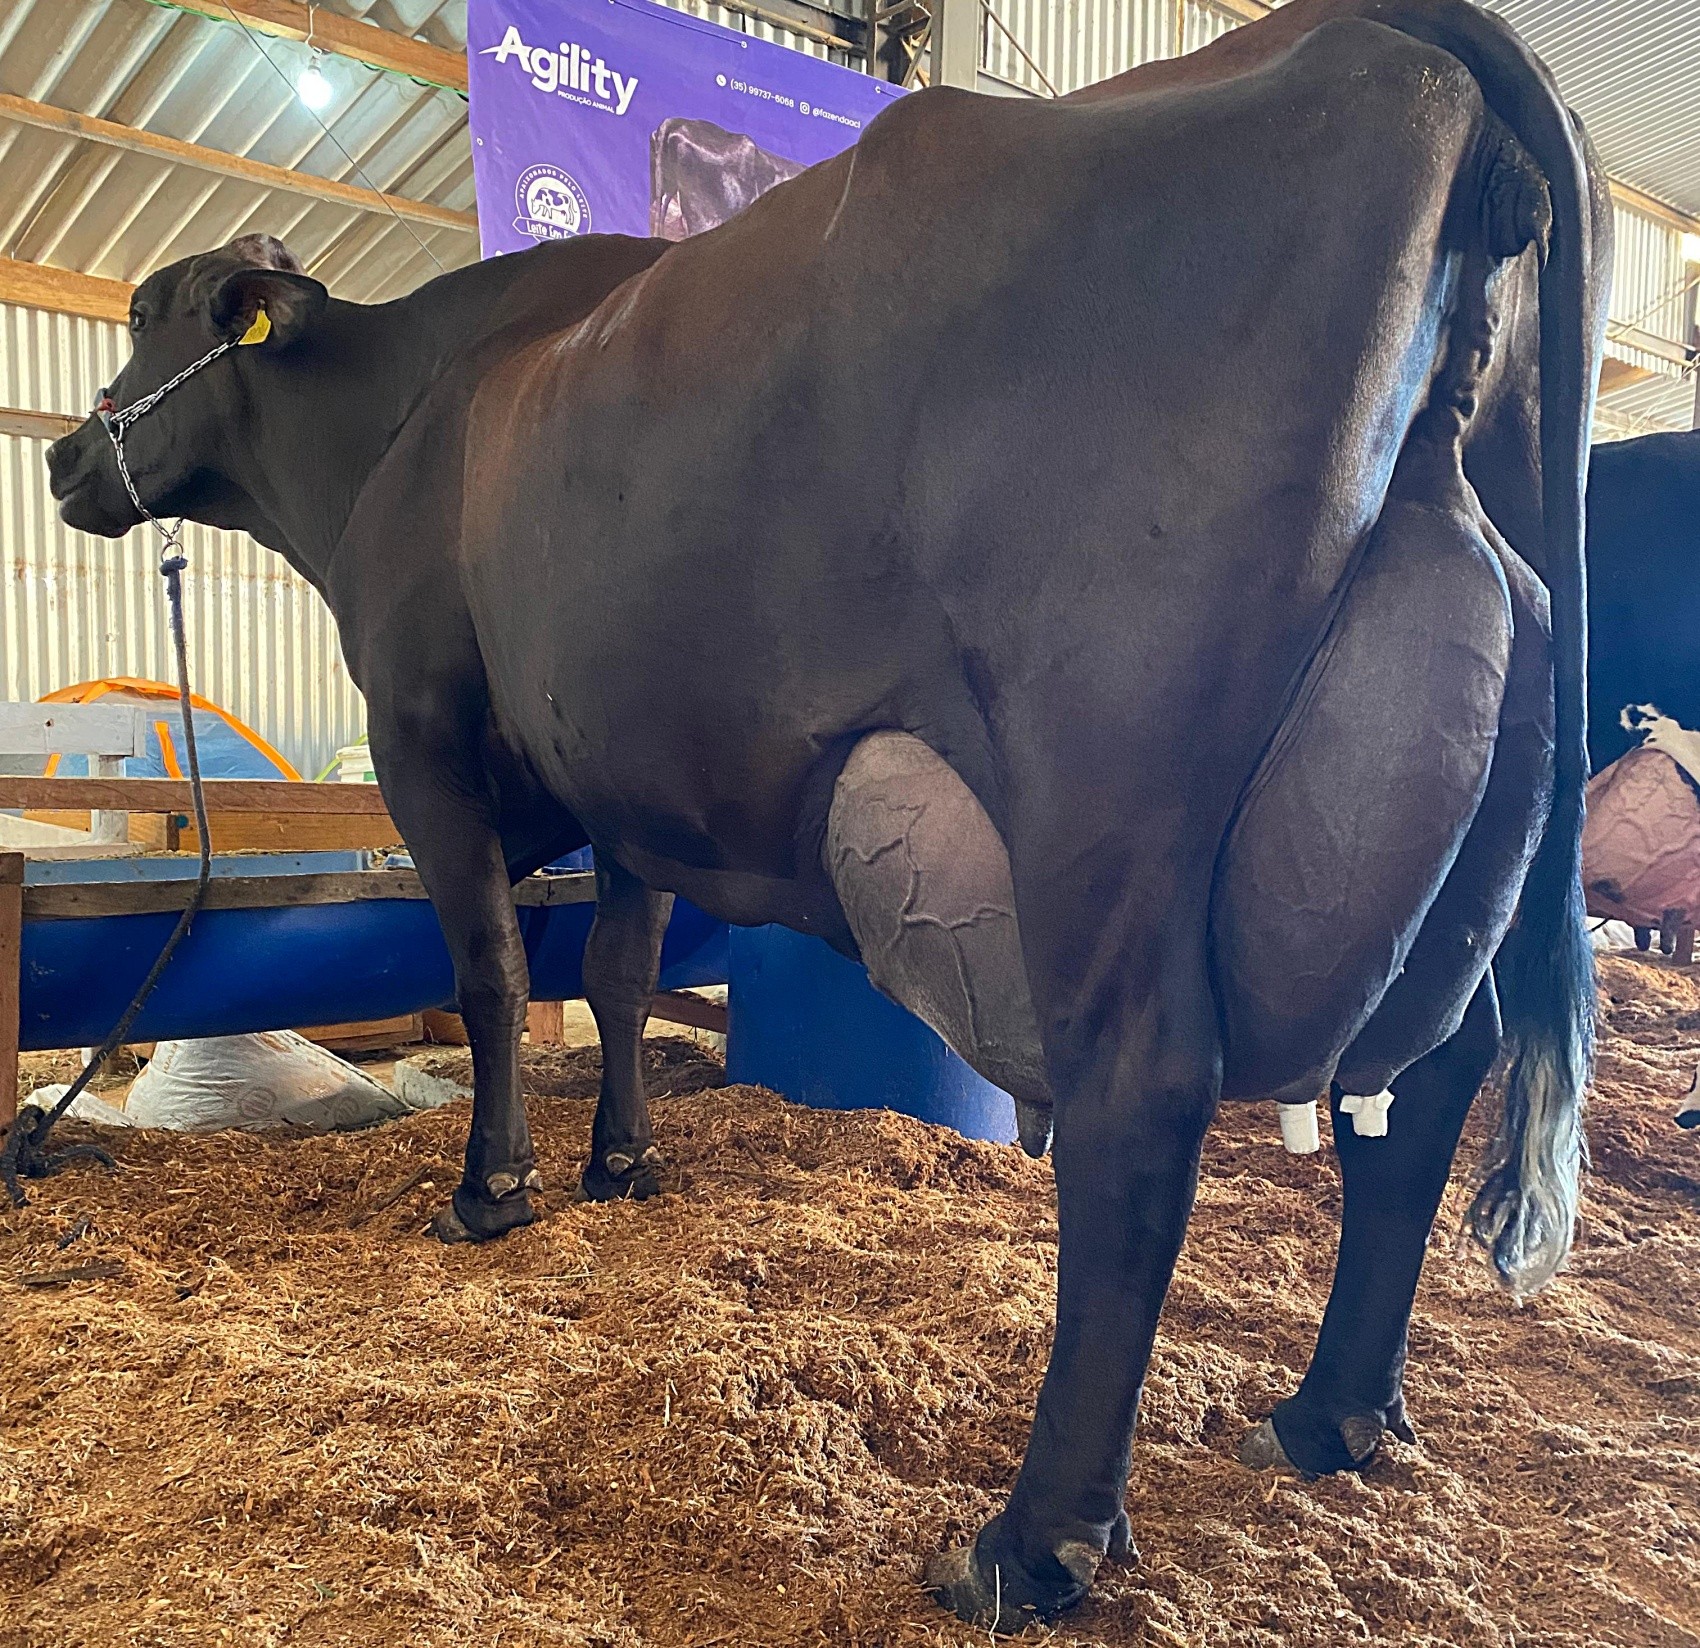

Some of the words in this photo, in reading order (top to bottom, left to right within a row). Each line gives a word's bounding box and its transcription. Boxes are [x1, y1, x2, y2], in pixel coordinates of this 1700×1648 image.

[478, 25, 639, 116] Agility
[730, 78, 747, 94] (35)
[557, 90, 592, 106] PRODUÇÃO
[592, 101, 615, 114] ANIMAL
[559, 173, 577, 191] PELO
[576, 193, 588, 219] LEITE
[526, 220, 548, 236] Leite
